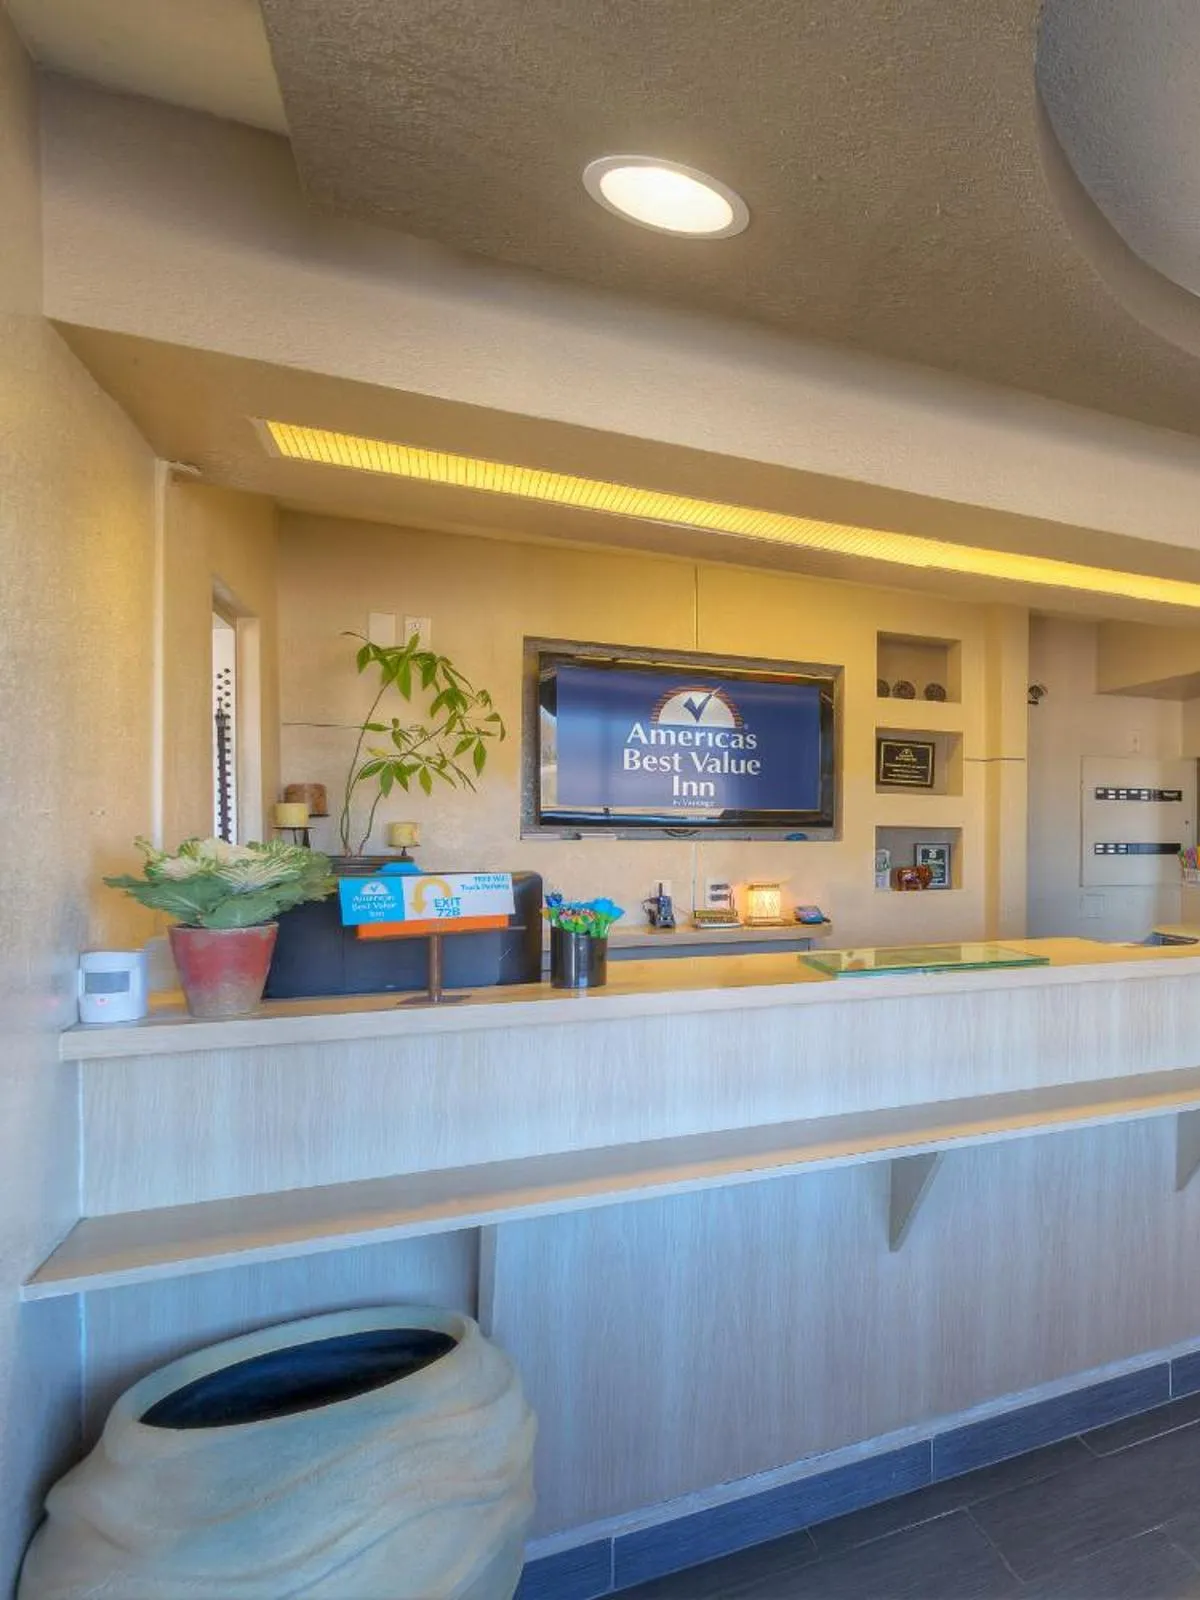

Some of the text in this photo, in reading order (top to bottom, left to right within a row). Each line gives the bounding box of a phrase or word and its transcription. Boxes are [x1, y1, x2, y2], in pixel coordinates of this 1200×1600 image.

[626, 722, 758, 750] Americas
[623, 748, 762, 775] Best Value
[672, 775, 715, 797] Inn
[434, 896, 461, 908] EXIT
